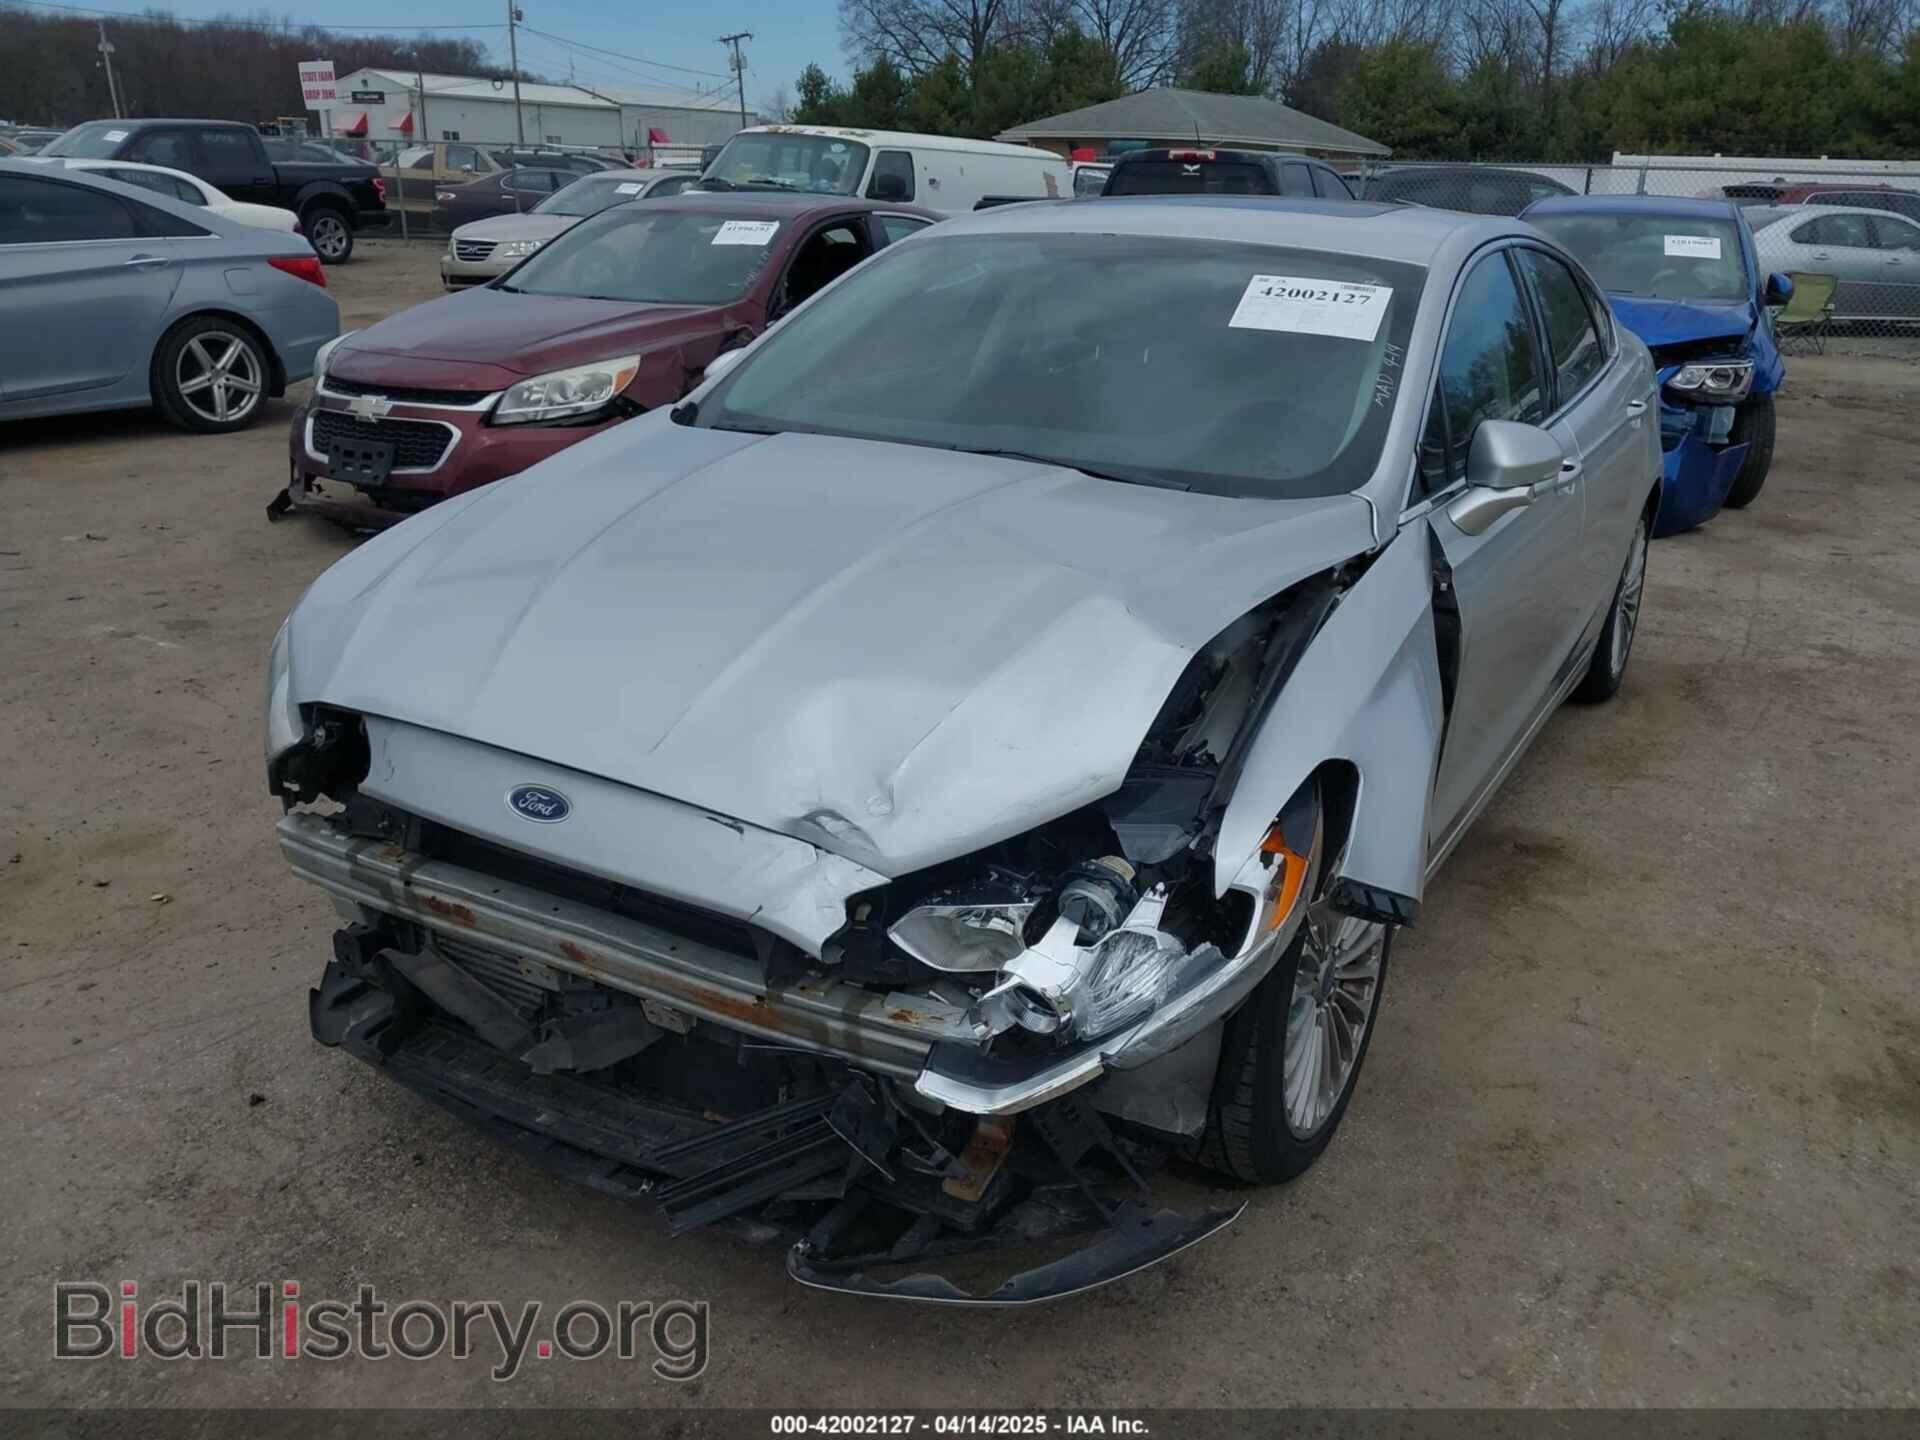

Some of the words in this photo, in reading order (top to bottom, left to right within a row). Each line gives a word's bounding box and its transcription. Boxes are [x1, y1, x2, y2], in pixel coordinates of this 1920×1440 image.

[1259, 285, 1371, 305] 42002127
[1375, 373, 1394, 408] MAD
[518, 791, 557, 816] Ford
